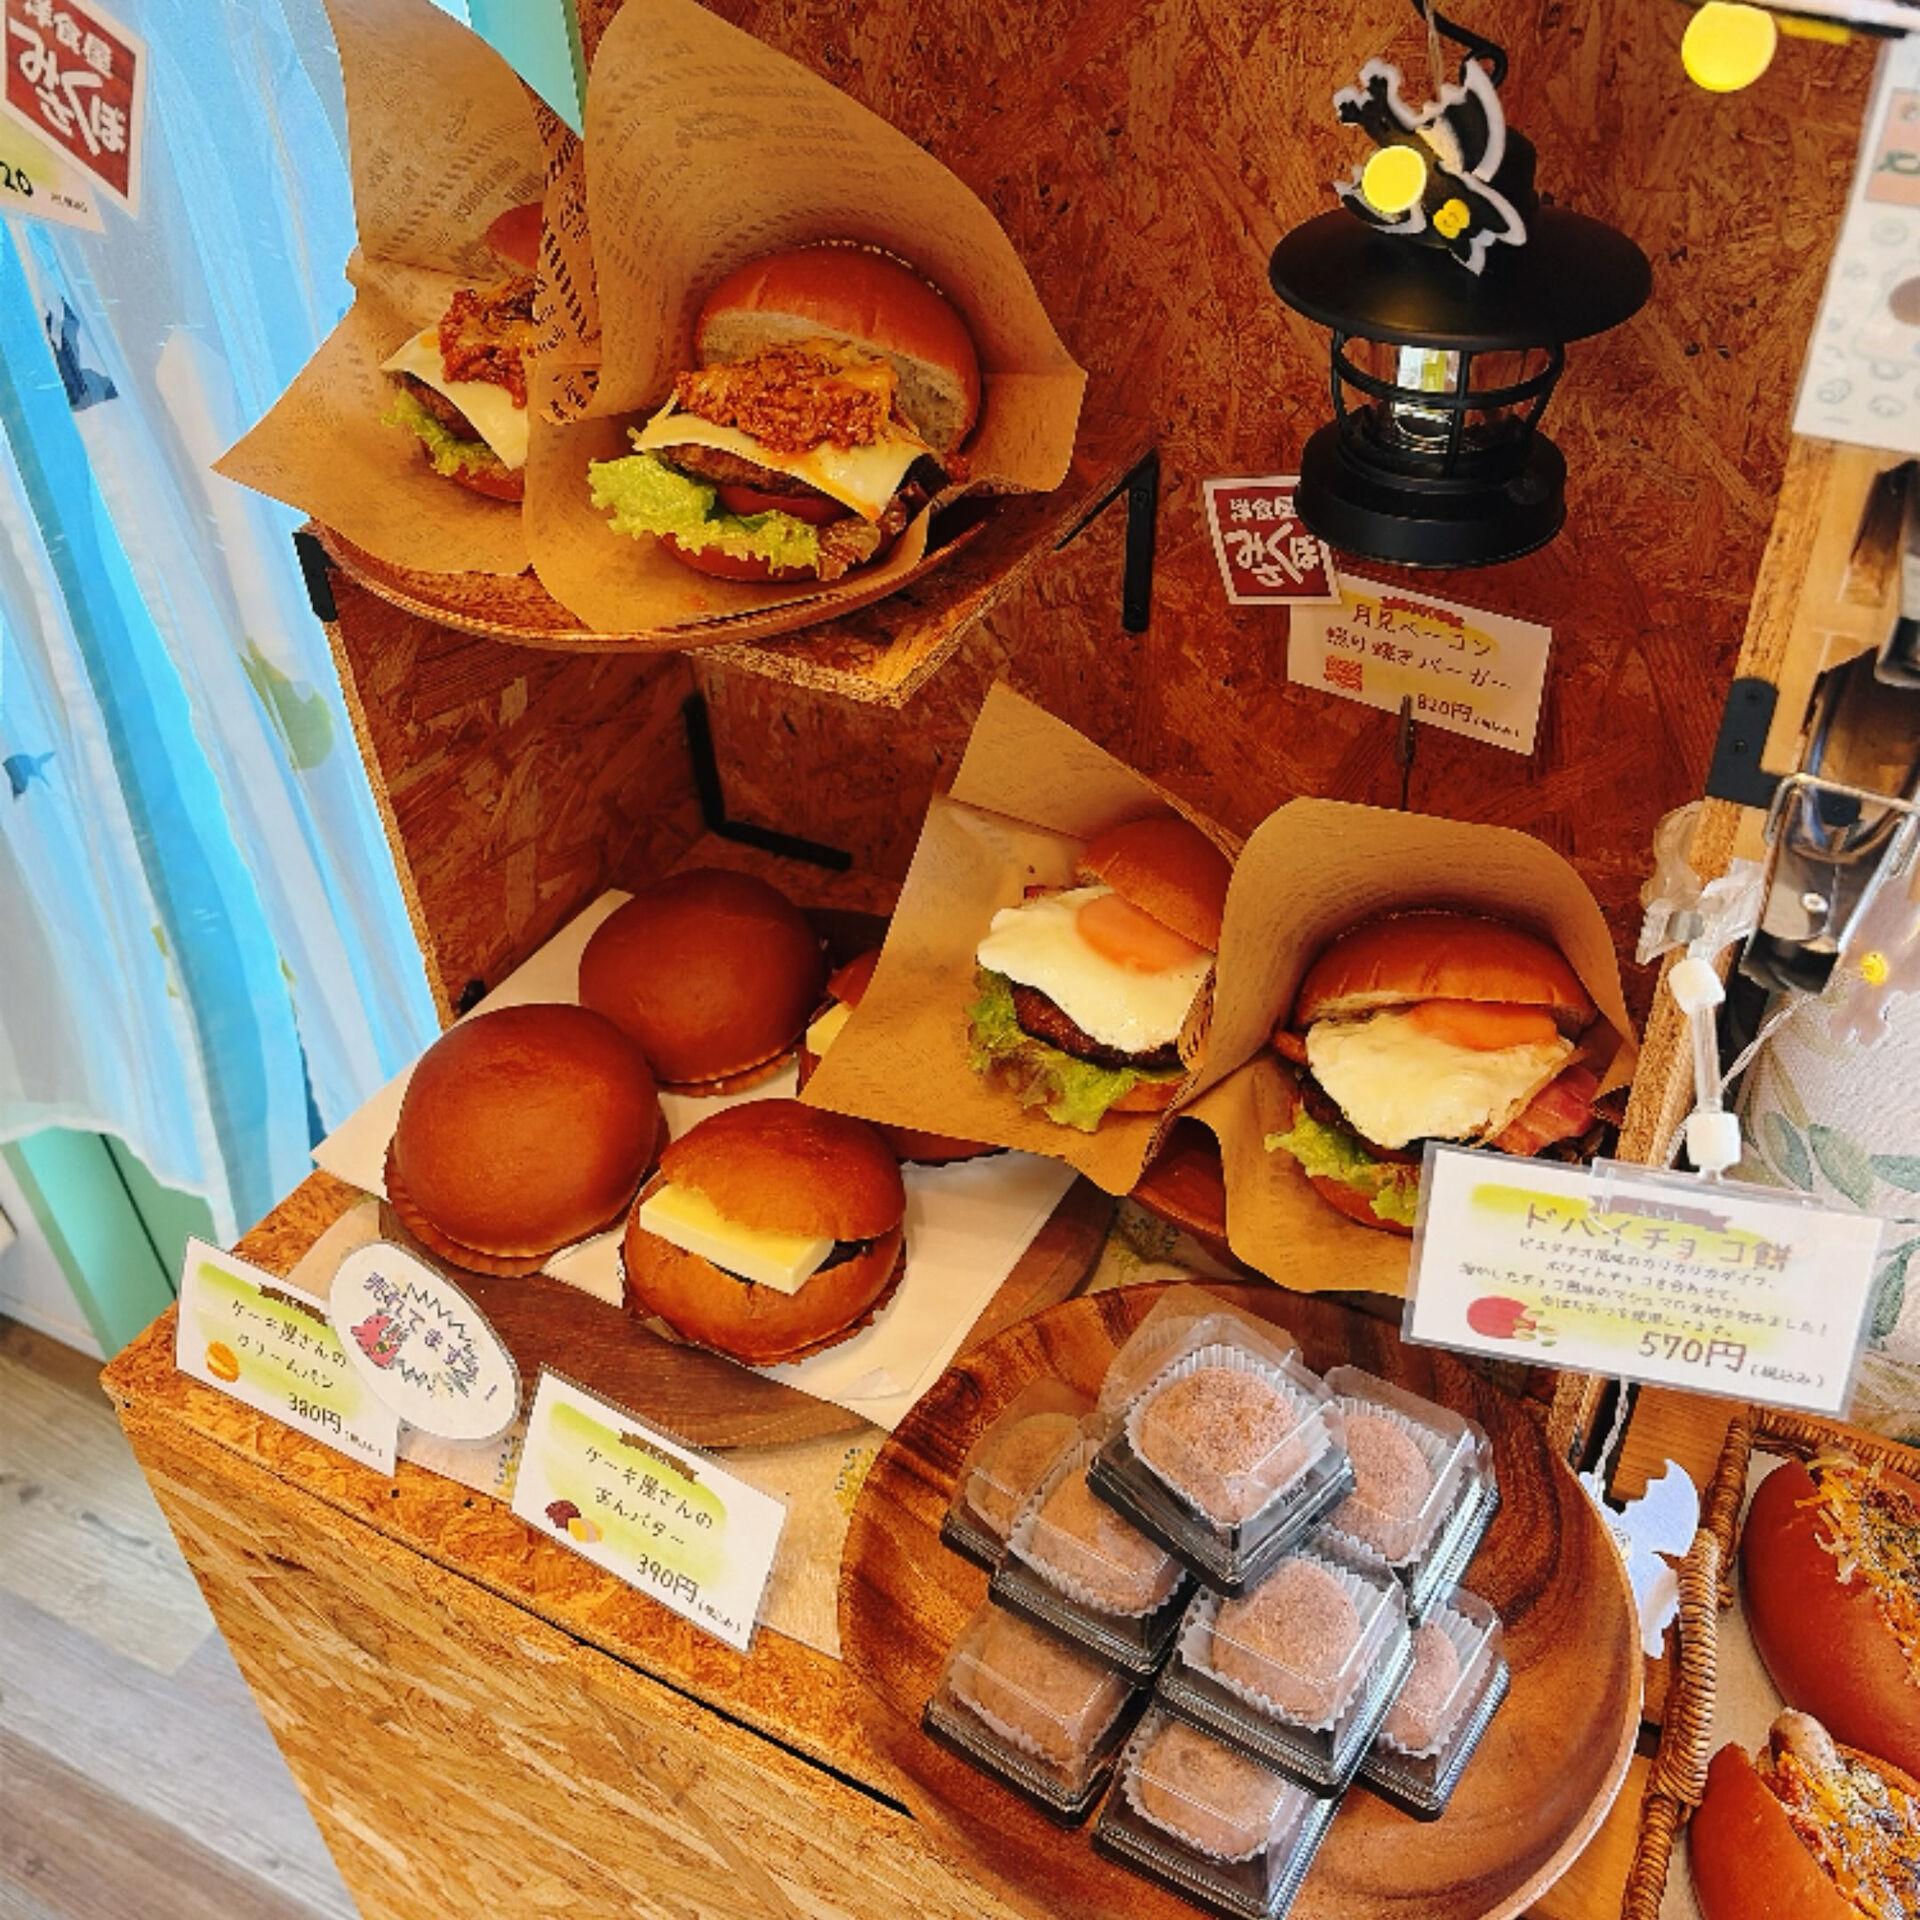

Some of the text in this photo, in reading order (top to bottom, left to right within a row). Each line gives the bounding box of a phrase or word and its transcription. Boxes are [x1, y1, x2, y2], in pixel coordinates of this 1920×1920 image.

[1229, 495, 1299, 522] 洋食屋
[1352, 603, 1491, 657] 月見ベーコン
[1417, 692, 1473, 724] 820円
[1638, 1330, 1747, 1373] 570円
[288, 1392, 342, 1435] 380円
[595, 1487, 685, 1545] あんバター
[637, 1553, 699, 1604] 390円
